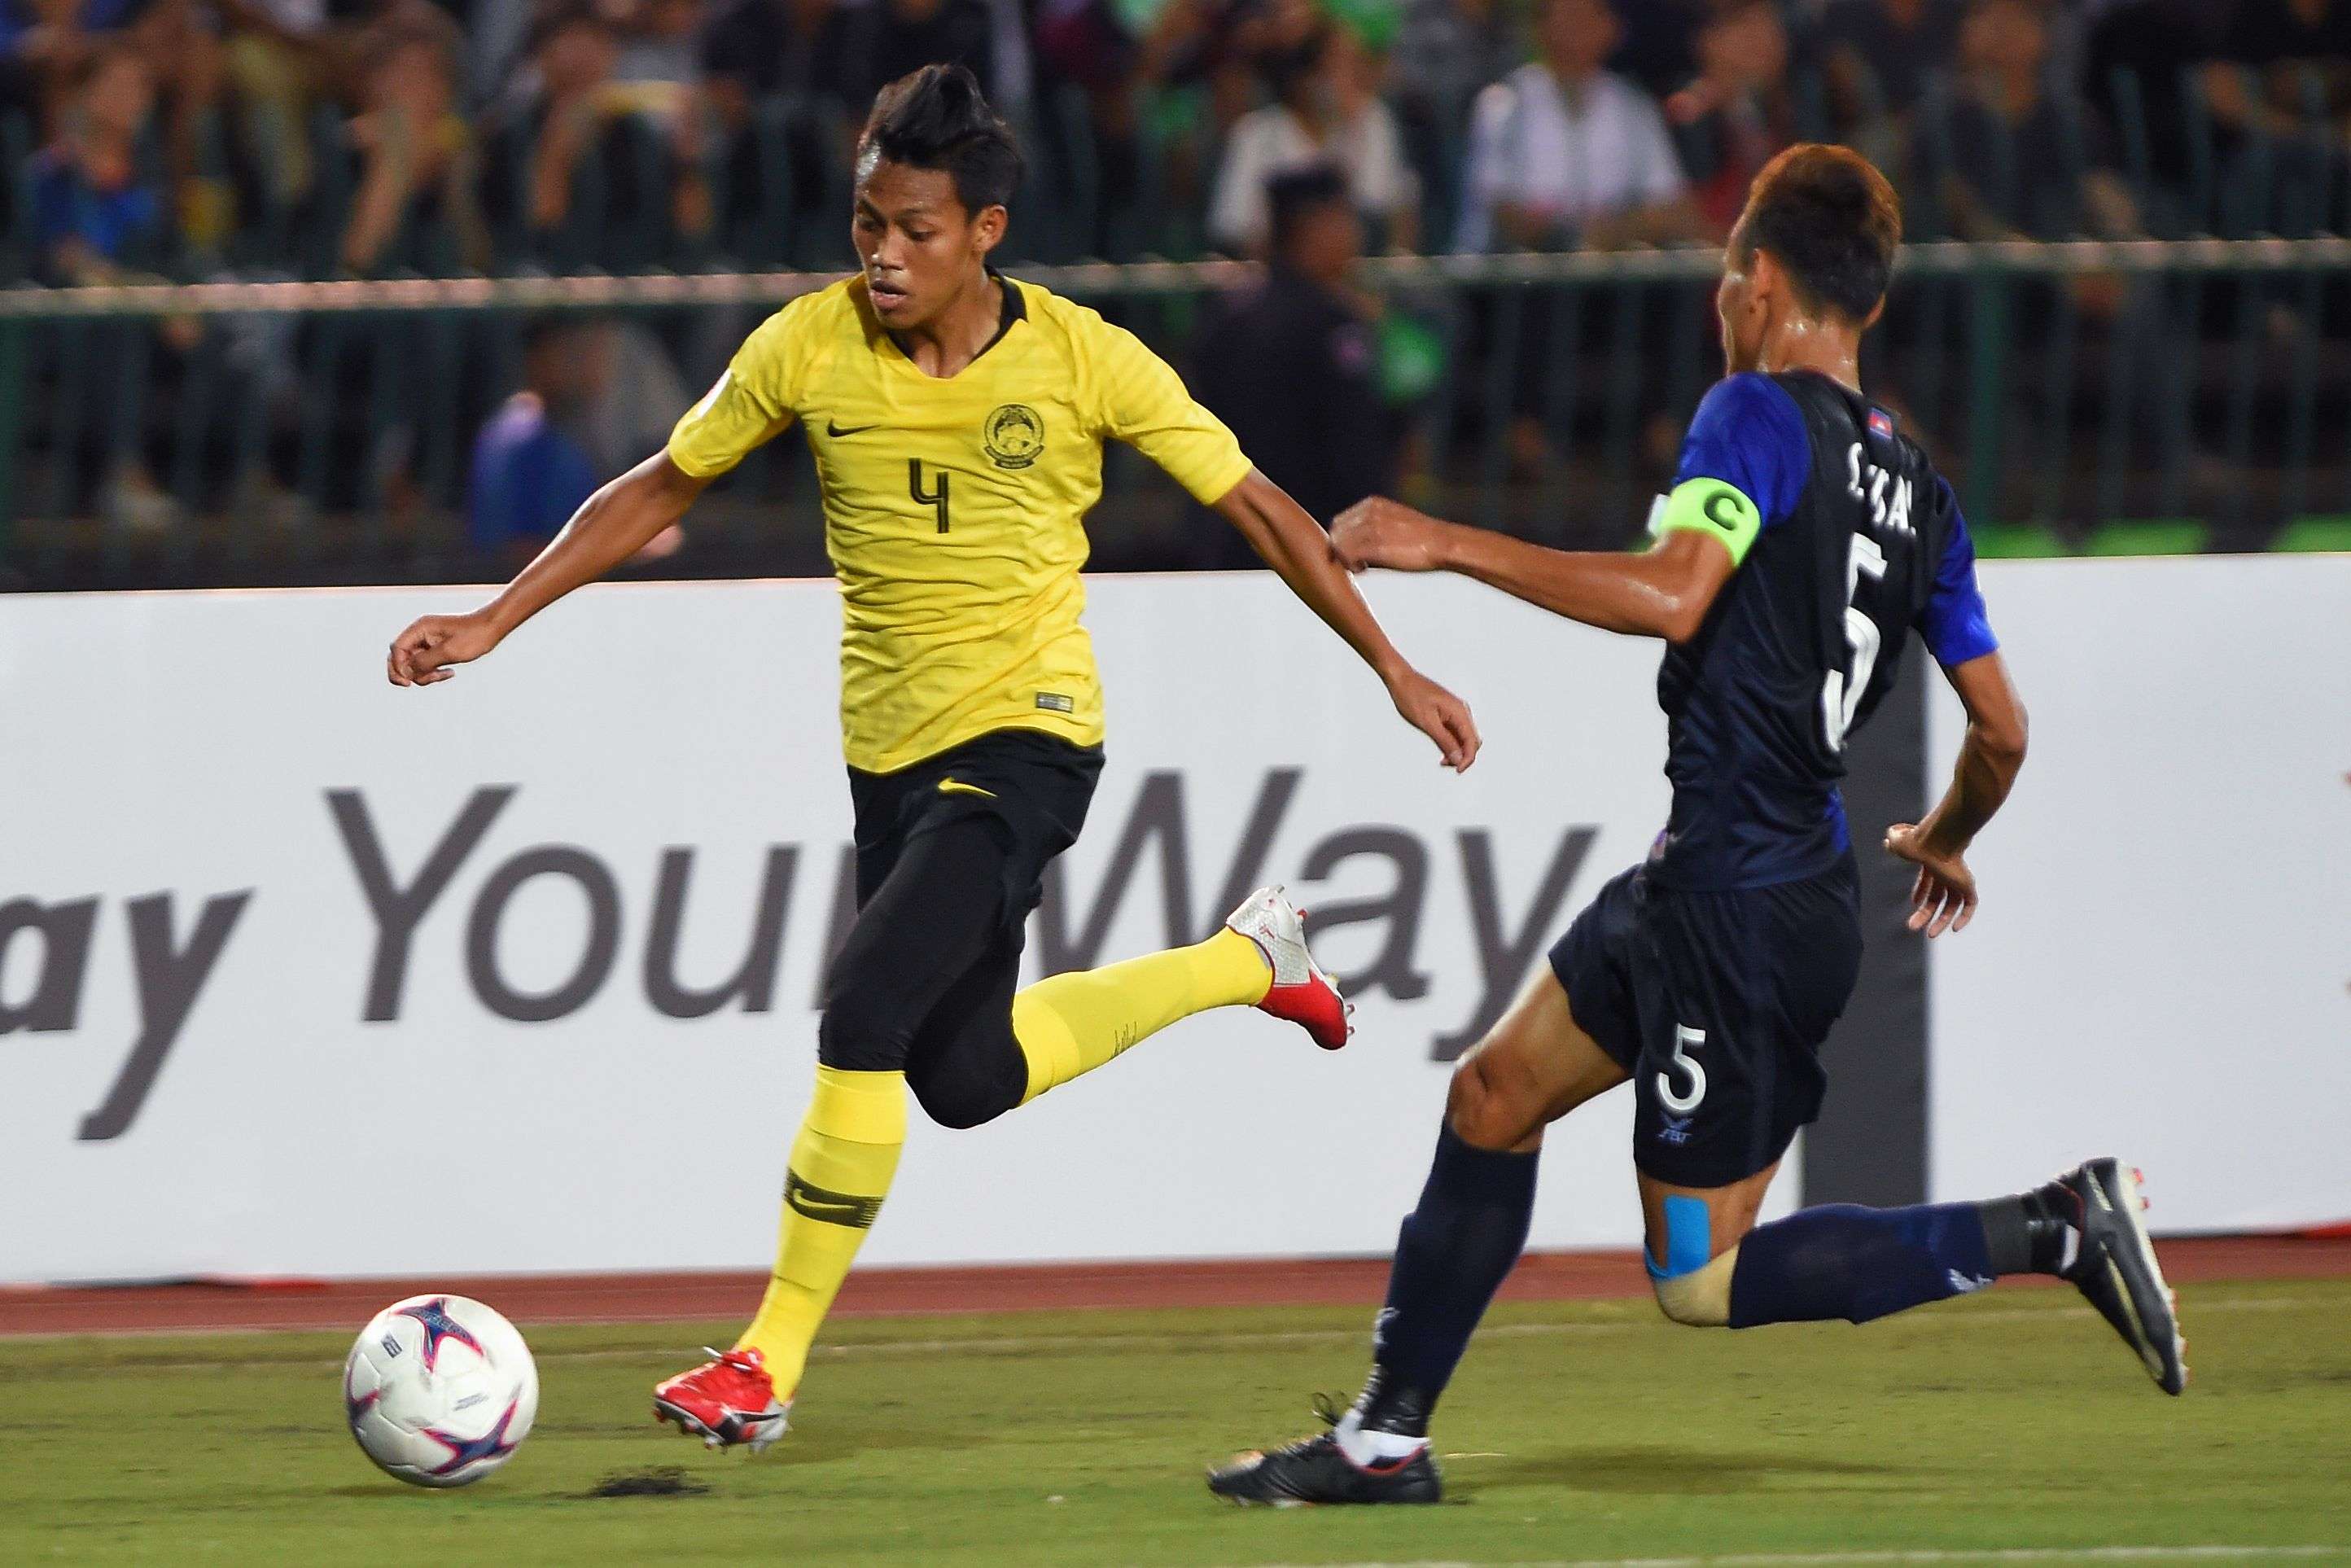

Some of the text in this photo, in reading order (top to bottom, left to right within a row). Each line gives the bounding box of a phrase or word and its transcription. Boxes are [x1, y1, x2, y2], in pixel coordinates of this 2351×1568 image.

[908, 458, 950, 534] 4
[1703, 488, 1745, 531] C
[1821, 532, 1888, 752] 5
[1658, 1023, 1706, 1111] 5
